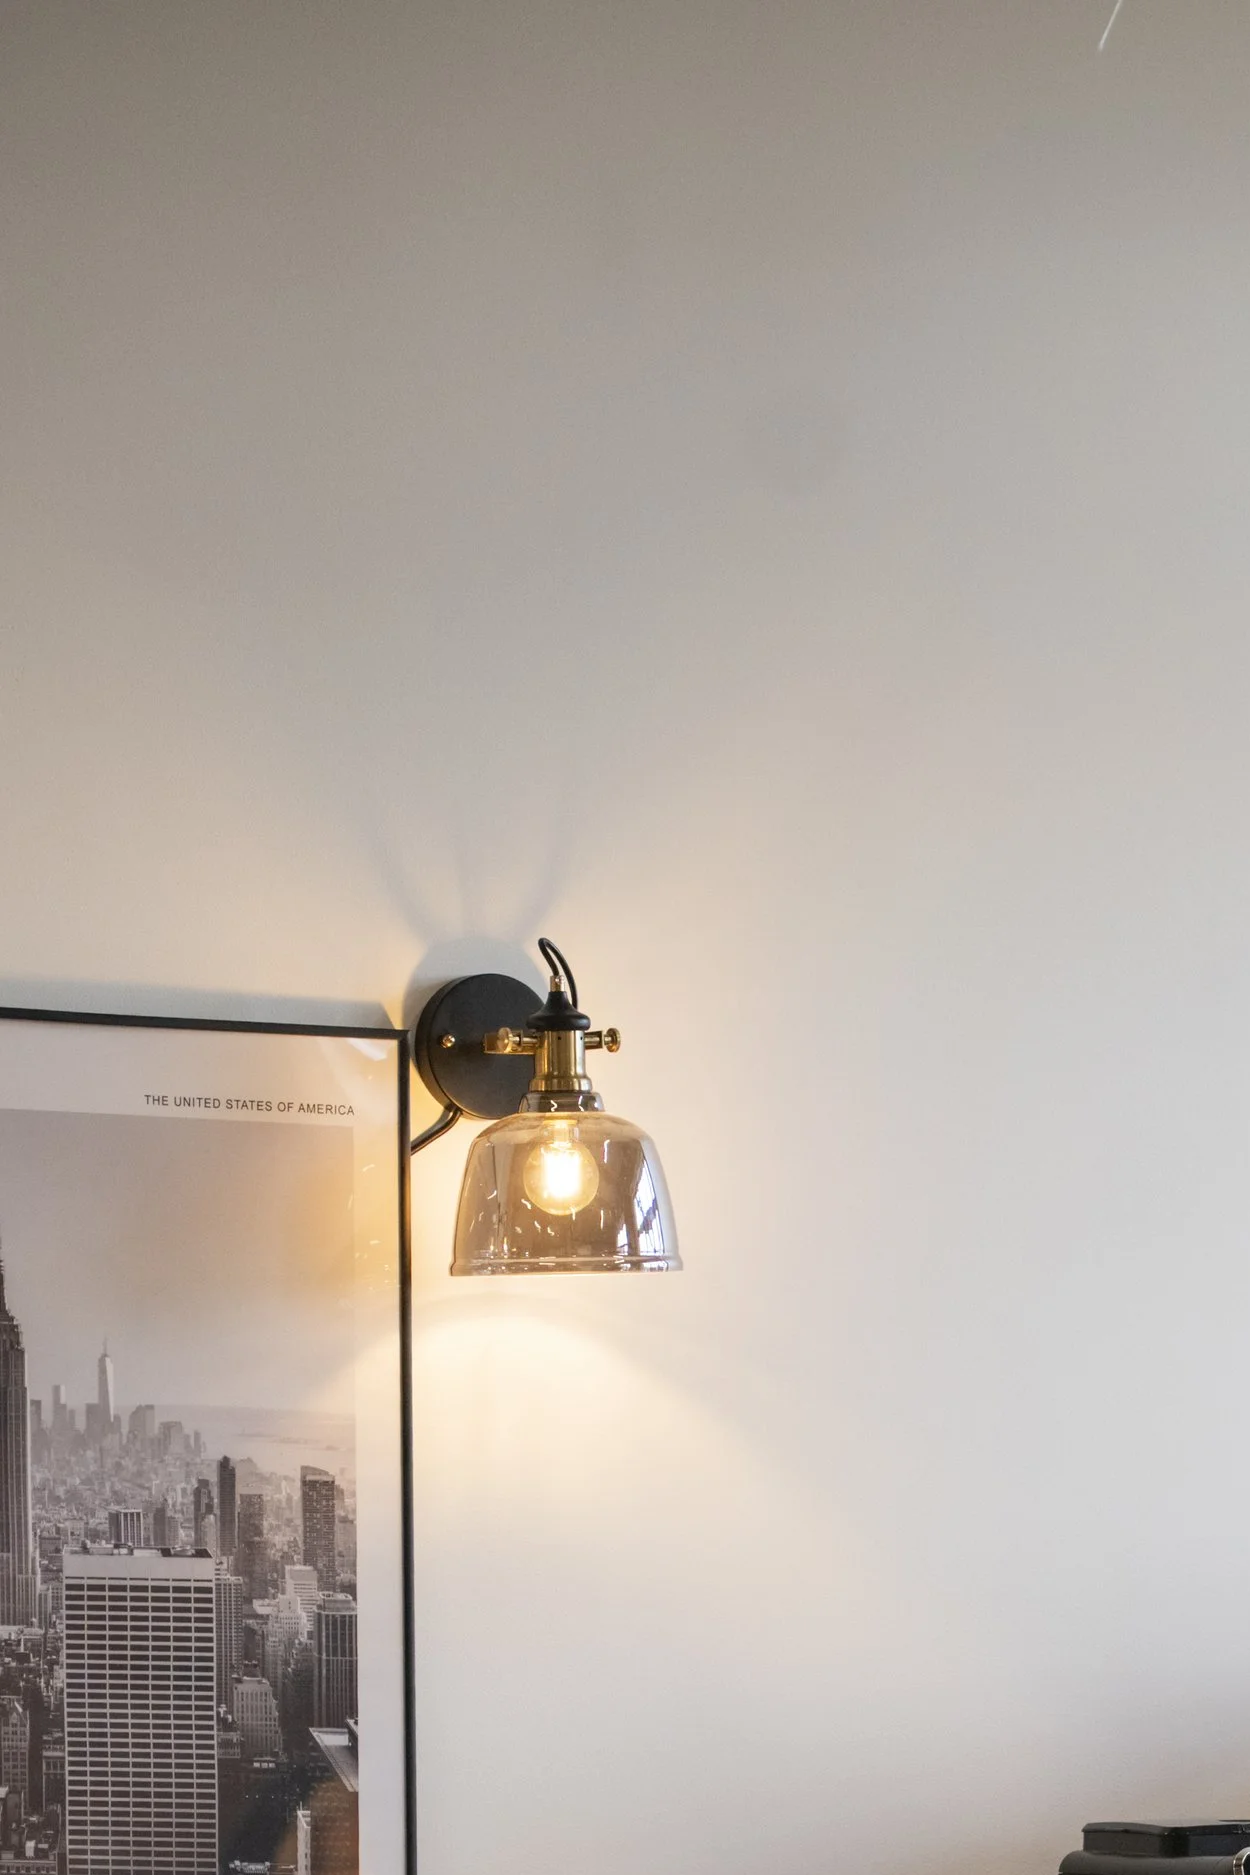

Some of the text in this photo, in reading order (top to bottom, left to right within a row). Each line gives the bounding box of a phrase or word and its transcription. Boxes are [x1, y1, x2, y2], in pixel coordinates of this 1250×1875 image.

[144, 1095, 354, 1116] THE UNITED STATES OF AMERICA
